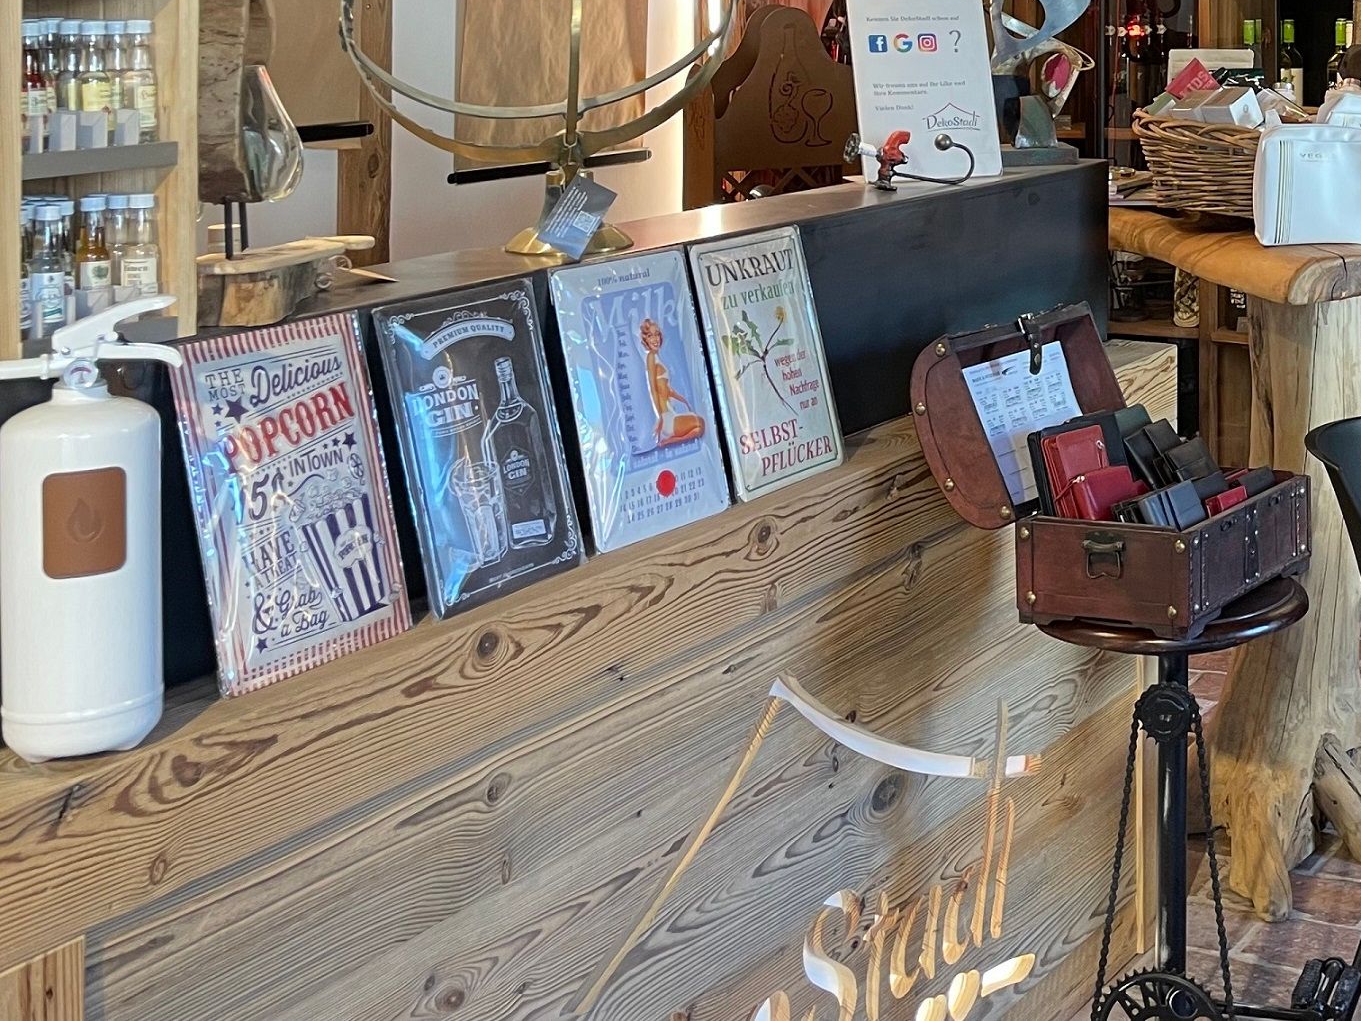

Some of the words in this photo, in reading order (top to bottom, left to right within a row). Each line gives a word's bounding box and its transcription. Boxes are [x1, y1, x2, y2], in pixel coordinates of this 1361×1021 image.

[705, 248, 794, 287] UNKRAUT
[722, 295, 738, 310] zu
[741, 279, 795, 304] verkaufen
[584, 285, 678, 343] Milk
[432, 324, 470, 348] PREMIUM
[470, 323, 505, 333] QUALITY
[205, 368, 244, 387] THE
[250, 355, 342, 407] Delicious
[208, 385, 246, 402] MOST
[413, 384, 480, 415] LONDON
[223, 382, 355, 473] POPCORN
[426, 401, 474, 427] GIN
[740, 419, 803, 455] SELBST-
[503, 459, 530, 473] LONDON
[761, 435, 833, 477] PFLÜCKER
[507, 468, 527, 480] GIN
[242, 530, 296, 576] HAVE
[253, 592, 278, 635] &
[293, 610, 331, 633] Bag
